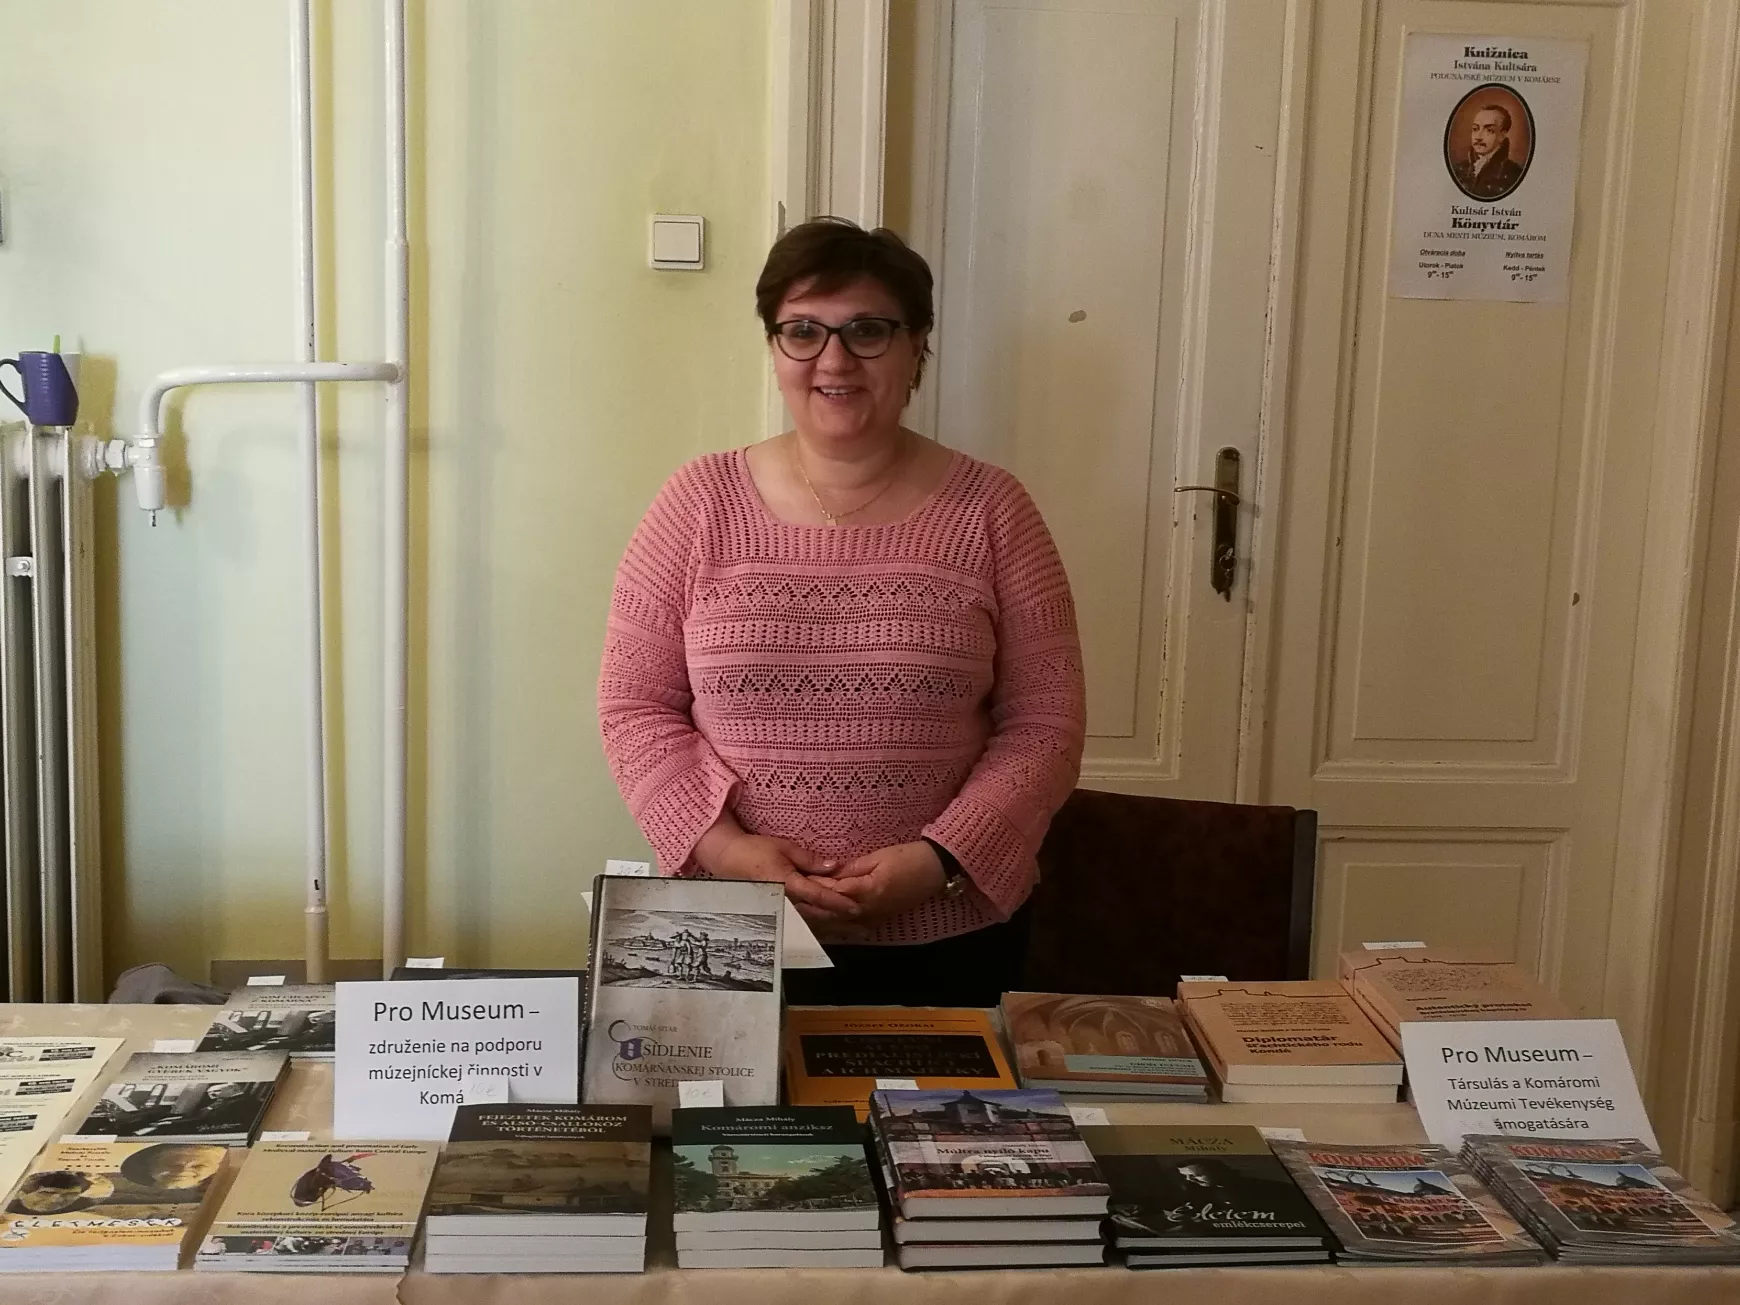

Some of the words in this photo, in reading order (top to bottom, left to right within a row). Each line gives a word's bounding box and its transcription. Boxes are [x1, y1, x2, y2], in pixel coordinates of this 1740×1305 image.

[1464, 46, 1528, 60] Knižnica
[1454, 60, 1491, 71] Istvána
[1494, 61, 1537, 72] Kultsára
[1451, 205, 1489, 216] Kultsár
[1491, 206, 1522, 217] István
[1451, 217, 1520, 232] Könyvtár
[373, 1002, 413, 1022] Pro
[1242, 1035, 1338, 1044] Diplomatár
[369, 1039, 446, 1055] združenie
[450, 1043, 470, 1054] na
[475, 1038, 542, 1056] podporu
[1442, 1047, 1479, 1064] Pro
[369, 1064, 463, 1082] múzejníckej
[533, 1065, 543, 1076] v
[709, 1066, 755, 1078] STOLICE
[1448, 1077, 1509, 1090] Társulás
[1512, 1081, 1522, 1089] a
[1524, 1076, 1601, 1090] Komáromi
[420, 1090, 464, 1105] Komá
[1447, 1098, 1517, 1111] Múzeumi
[1519, 1097, 1616, 1112] Tevékenység
[554, 1114, 628, 1122] KOMÁROM
[1494, 1117, 1590, 1131] ámogatására
[700, 1123, 778, 1131] Komáromi
[780, 1123, 834, 1131] anziksz
